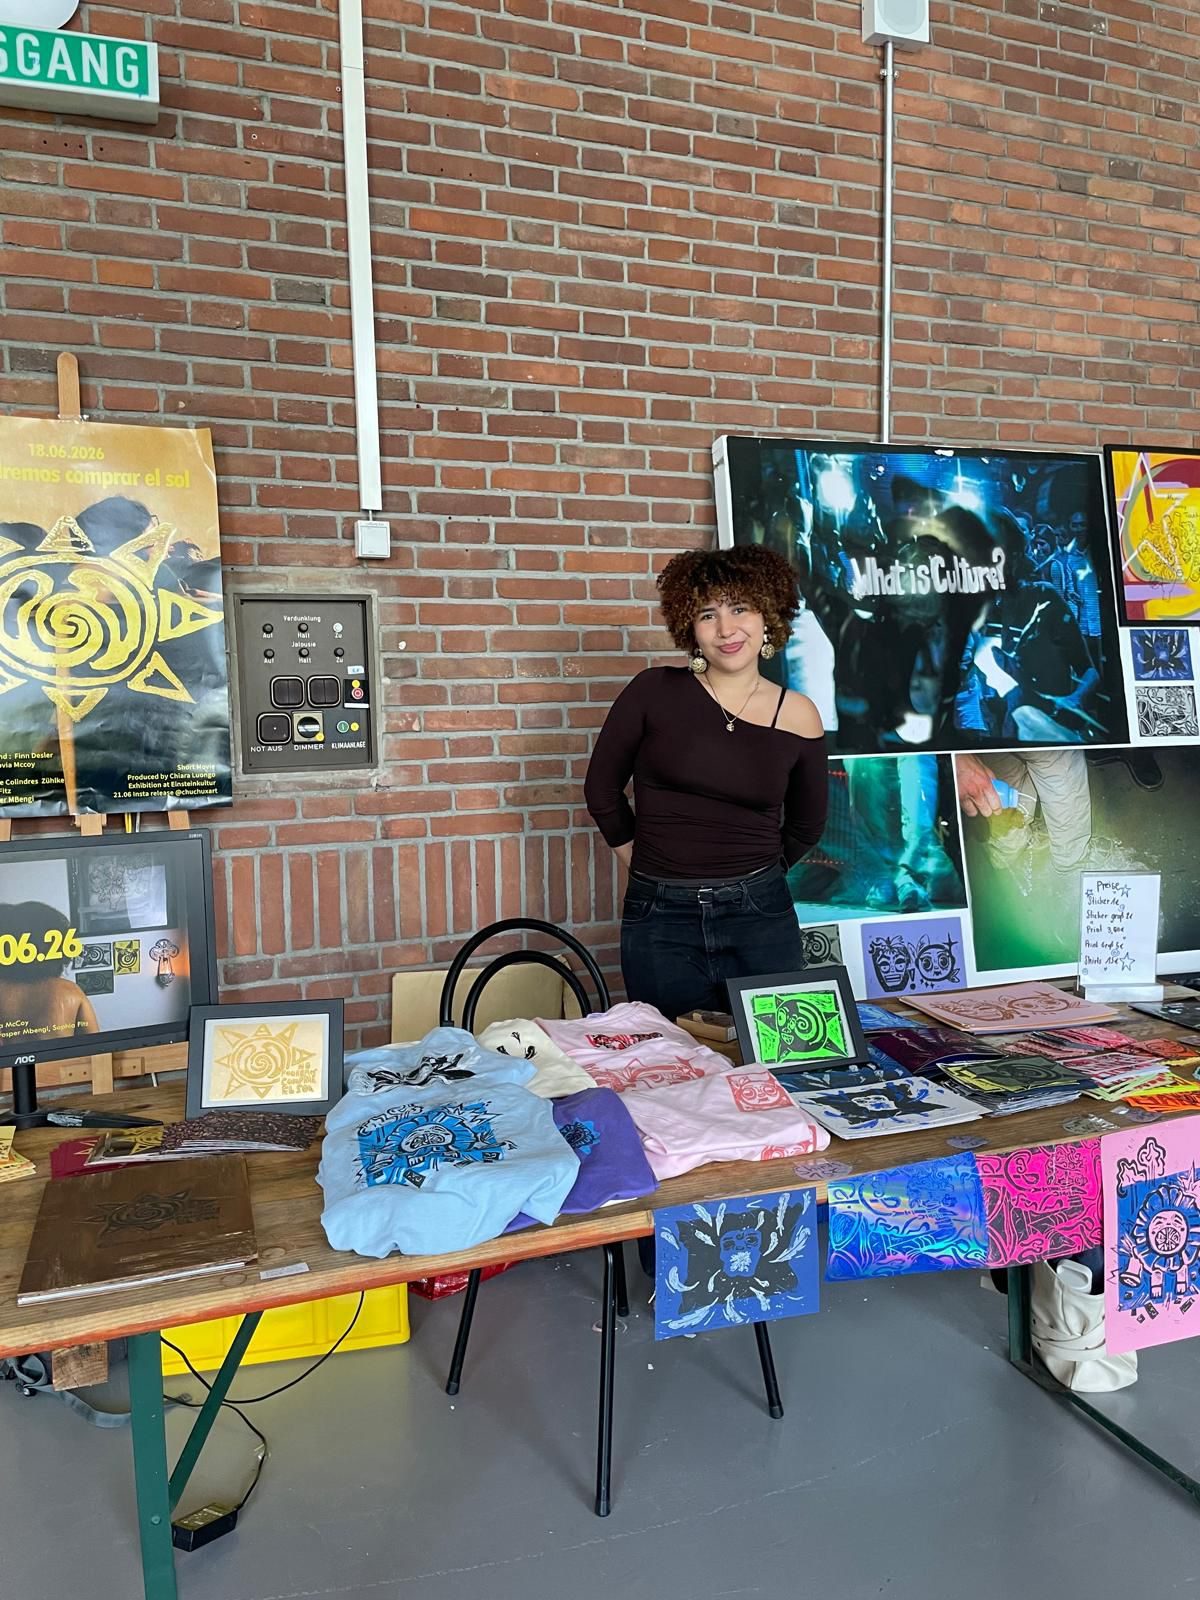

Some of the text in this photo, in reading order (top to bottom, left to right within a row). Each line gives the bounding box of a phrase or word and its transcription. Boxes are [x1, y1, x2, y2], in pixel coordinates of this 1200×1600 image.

[28, 443, 104, 460] 18.06.2026
[0, 466, 190, 488] remos comprar el sol
[848, 557, 905, 599] What
[929, 546, 1006, 595] Culture?
[175, 788, 218, 796] @chuchuxart
[1096, 880, 1120, 892] Preise
[0, 928, 83, 966] 06.26
[15, 1055, 35, 1064] AOC
